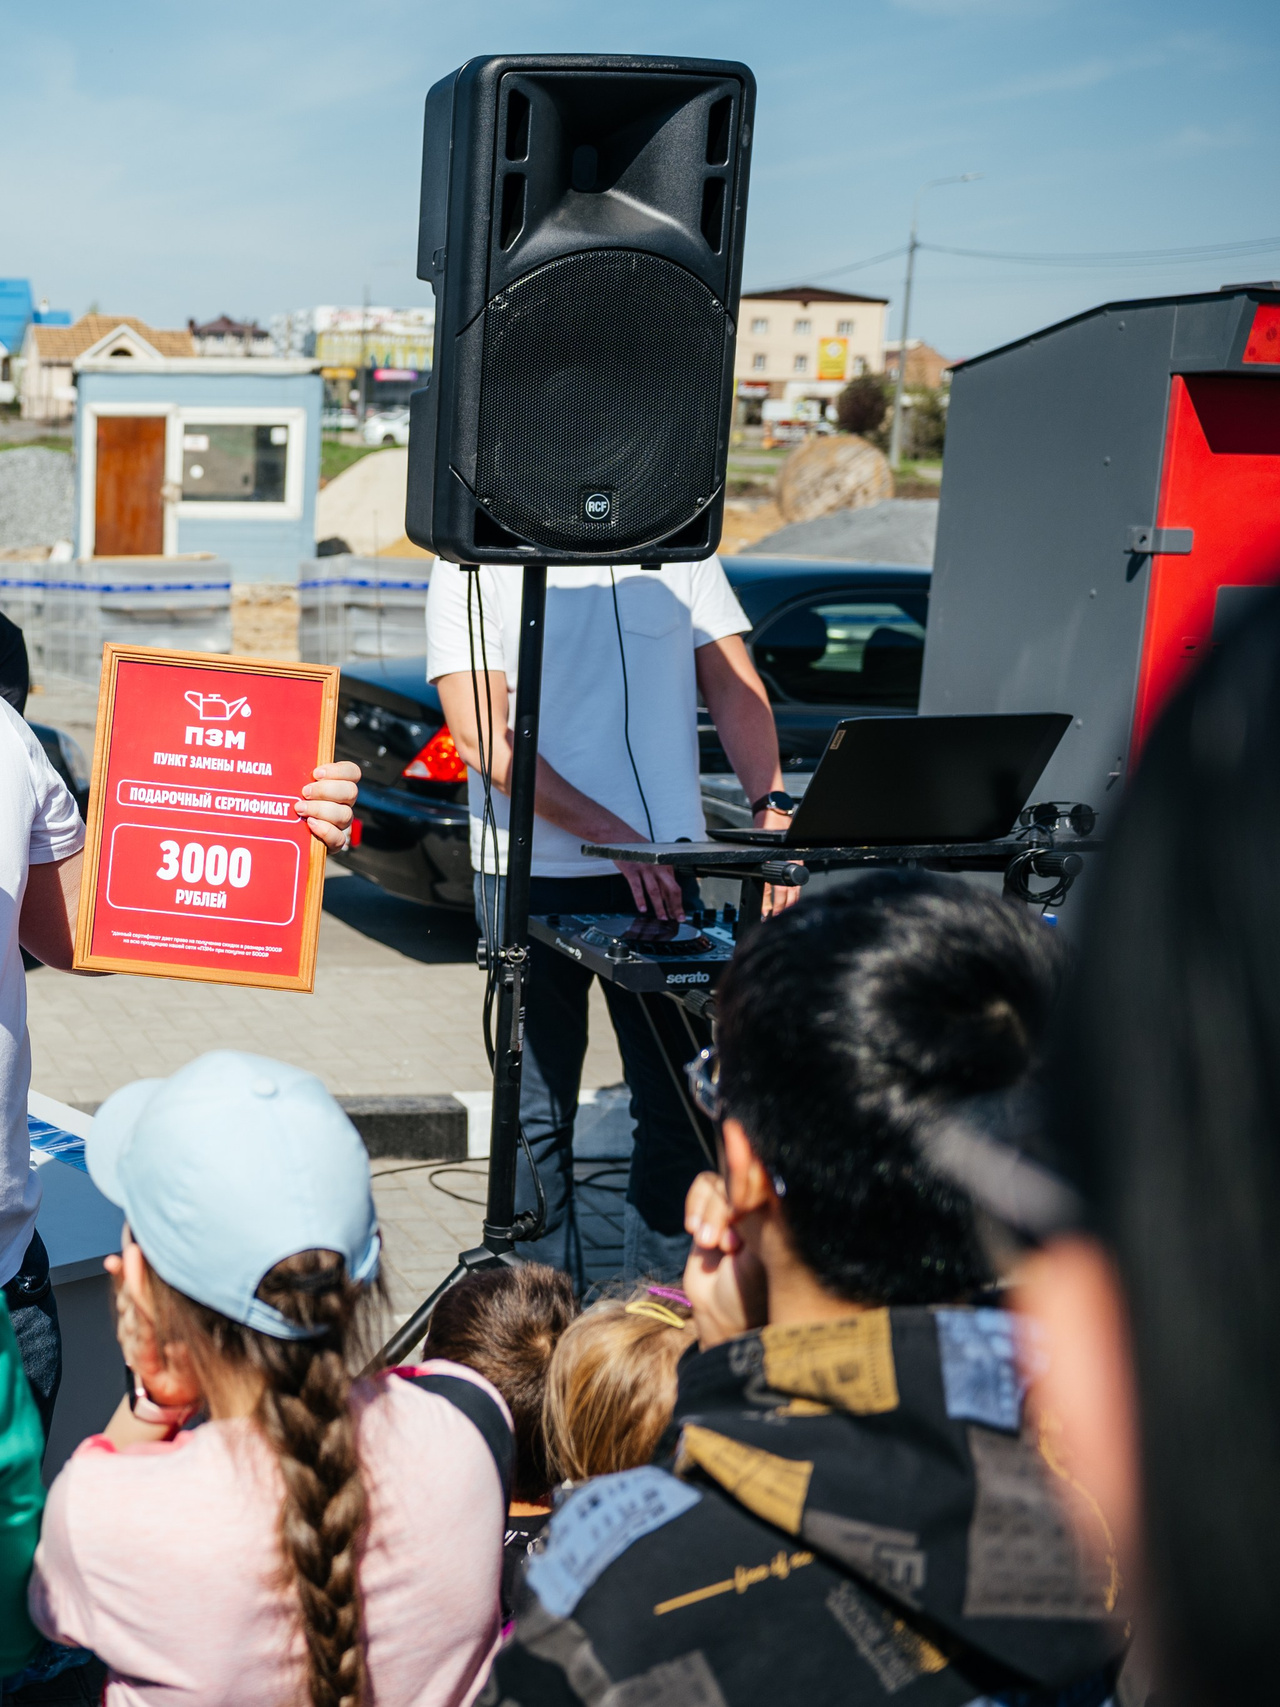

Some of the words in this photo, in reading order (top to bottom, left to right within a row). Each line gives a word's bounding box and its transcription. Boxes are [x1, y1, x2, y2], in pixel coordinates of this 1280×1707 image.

[588, 501, 607, 512] RCF
[185, 726, 246, 750] ПЗМ
[153, 752, 188, 767] ПУНКТ
[190, 756, 234, 772] ЗАМЕНЫ
[236, 760, 272, 776] МАСЛА
[130, 787, 212, 808] ПОДАРОЧНЫЙ
[214, 796, 290, 816] СЕРТИФИКАТ
[156, 840, 252, 888] 3000
[175, 888, 227, 908] РУБЛЕЙ
[666, 972, 710, 984] serato
